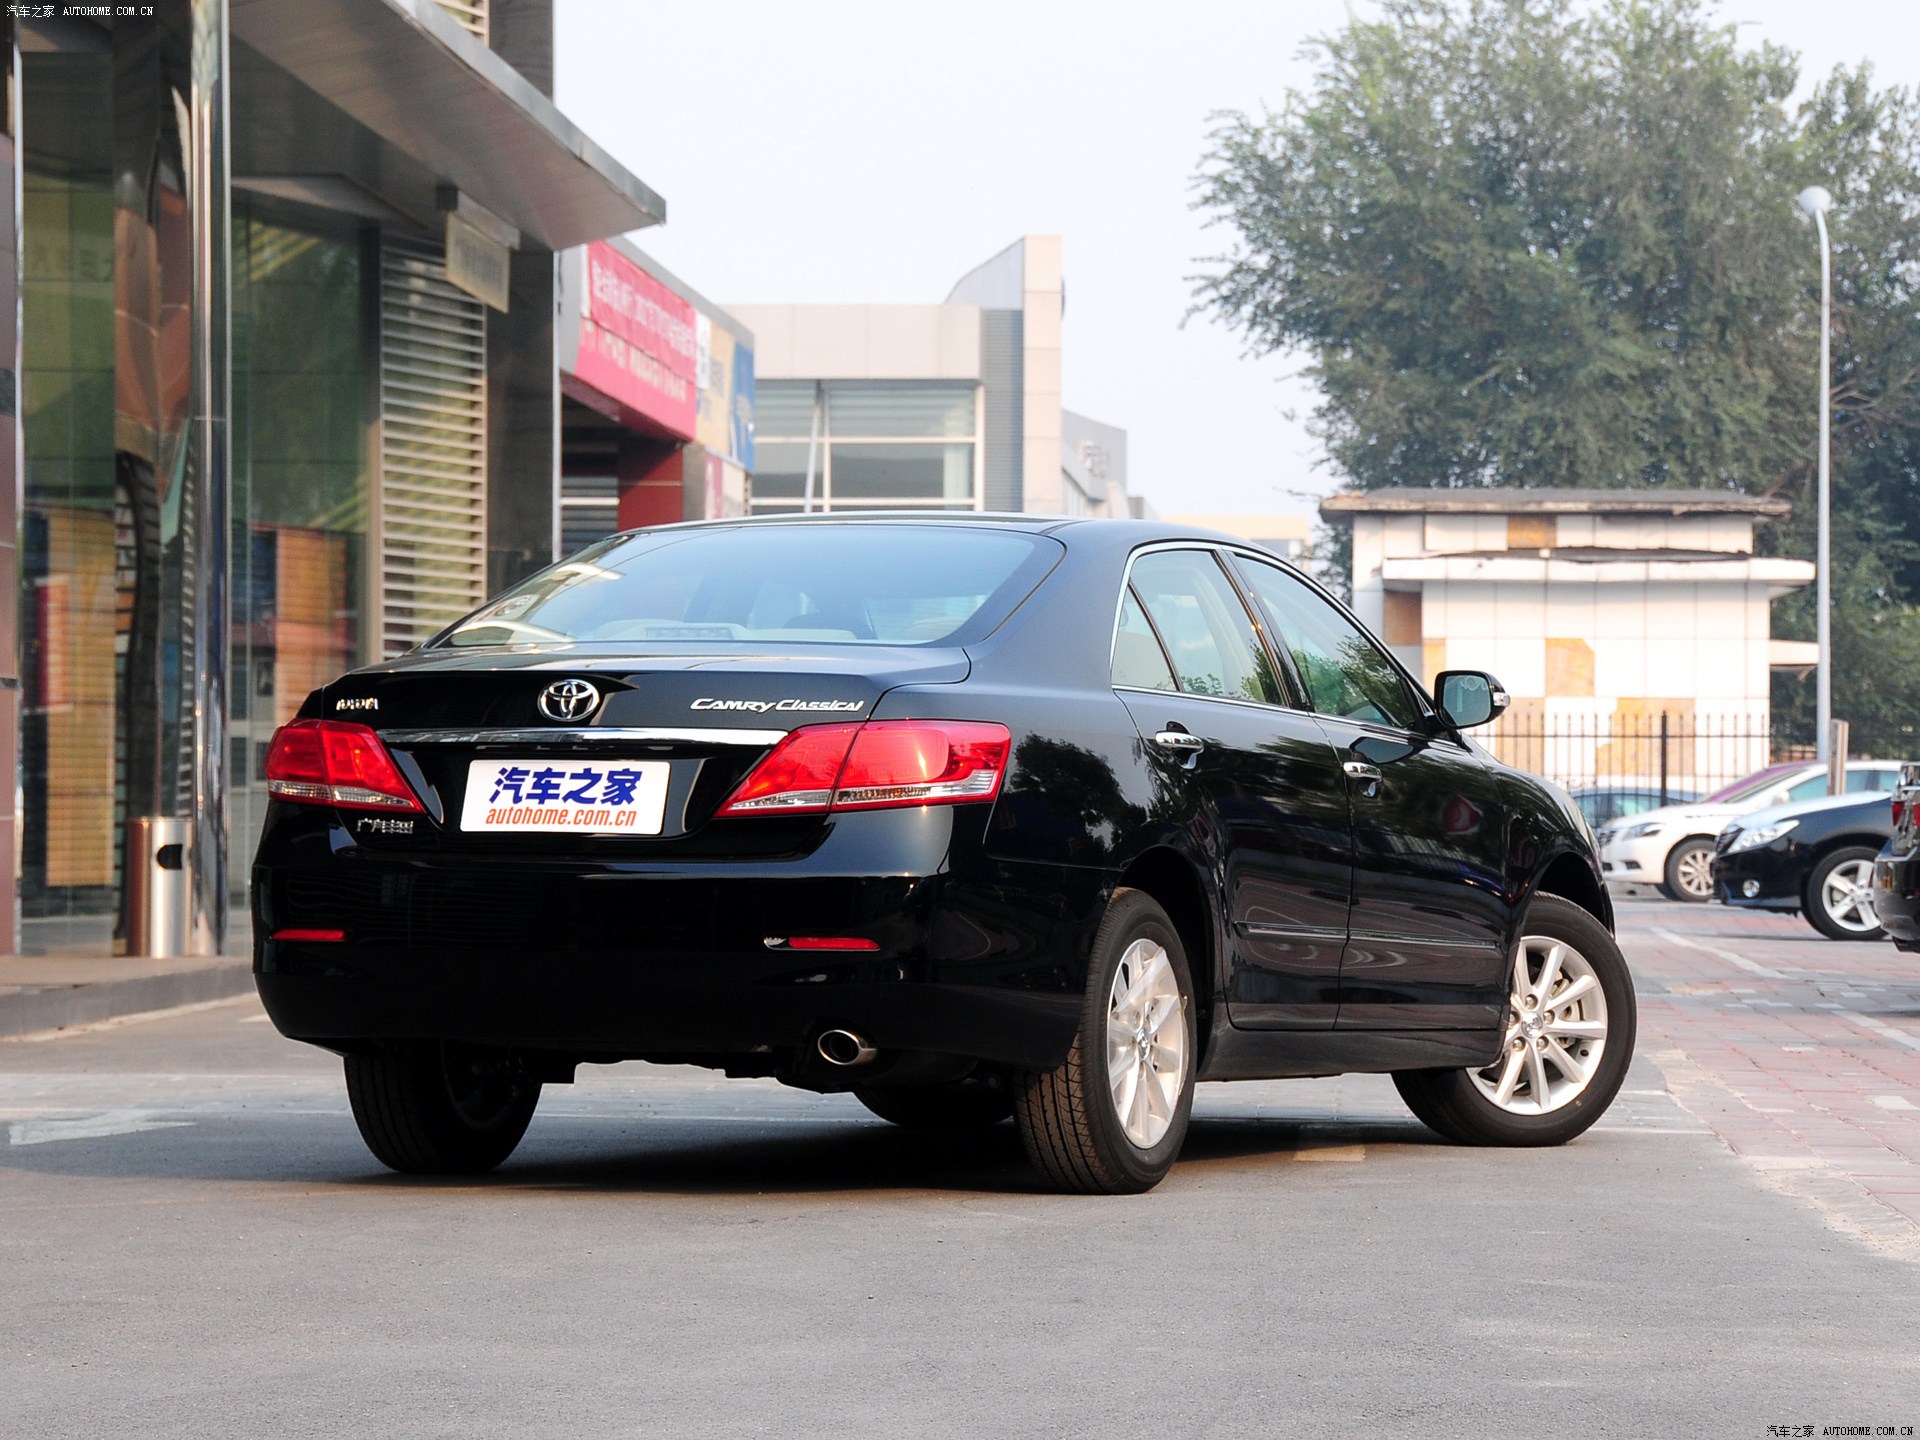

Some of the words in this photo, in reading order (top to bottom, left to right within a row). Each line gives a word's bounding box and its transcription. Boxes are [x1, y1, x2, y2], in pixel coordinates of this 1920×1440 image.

[489, 767, 643, 806] 汽车之家
[485, 807, 637, 827] autohome.com.cn
